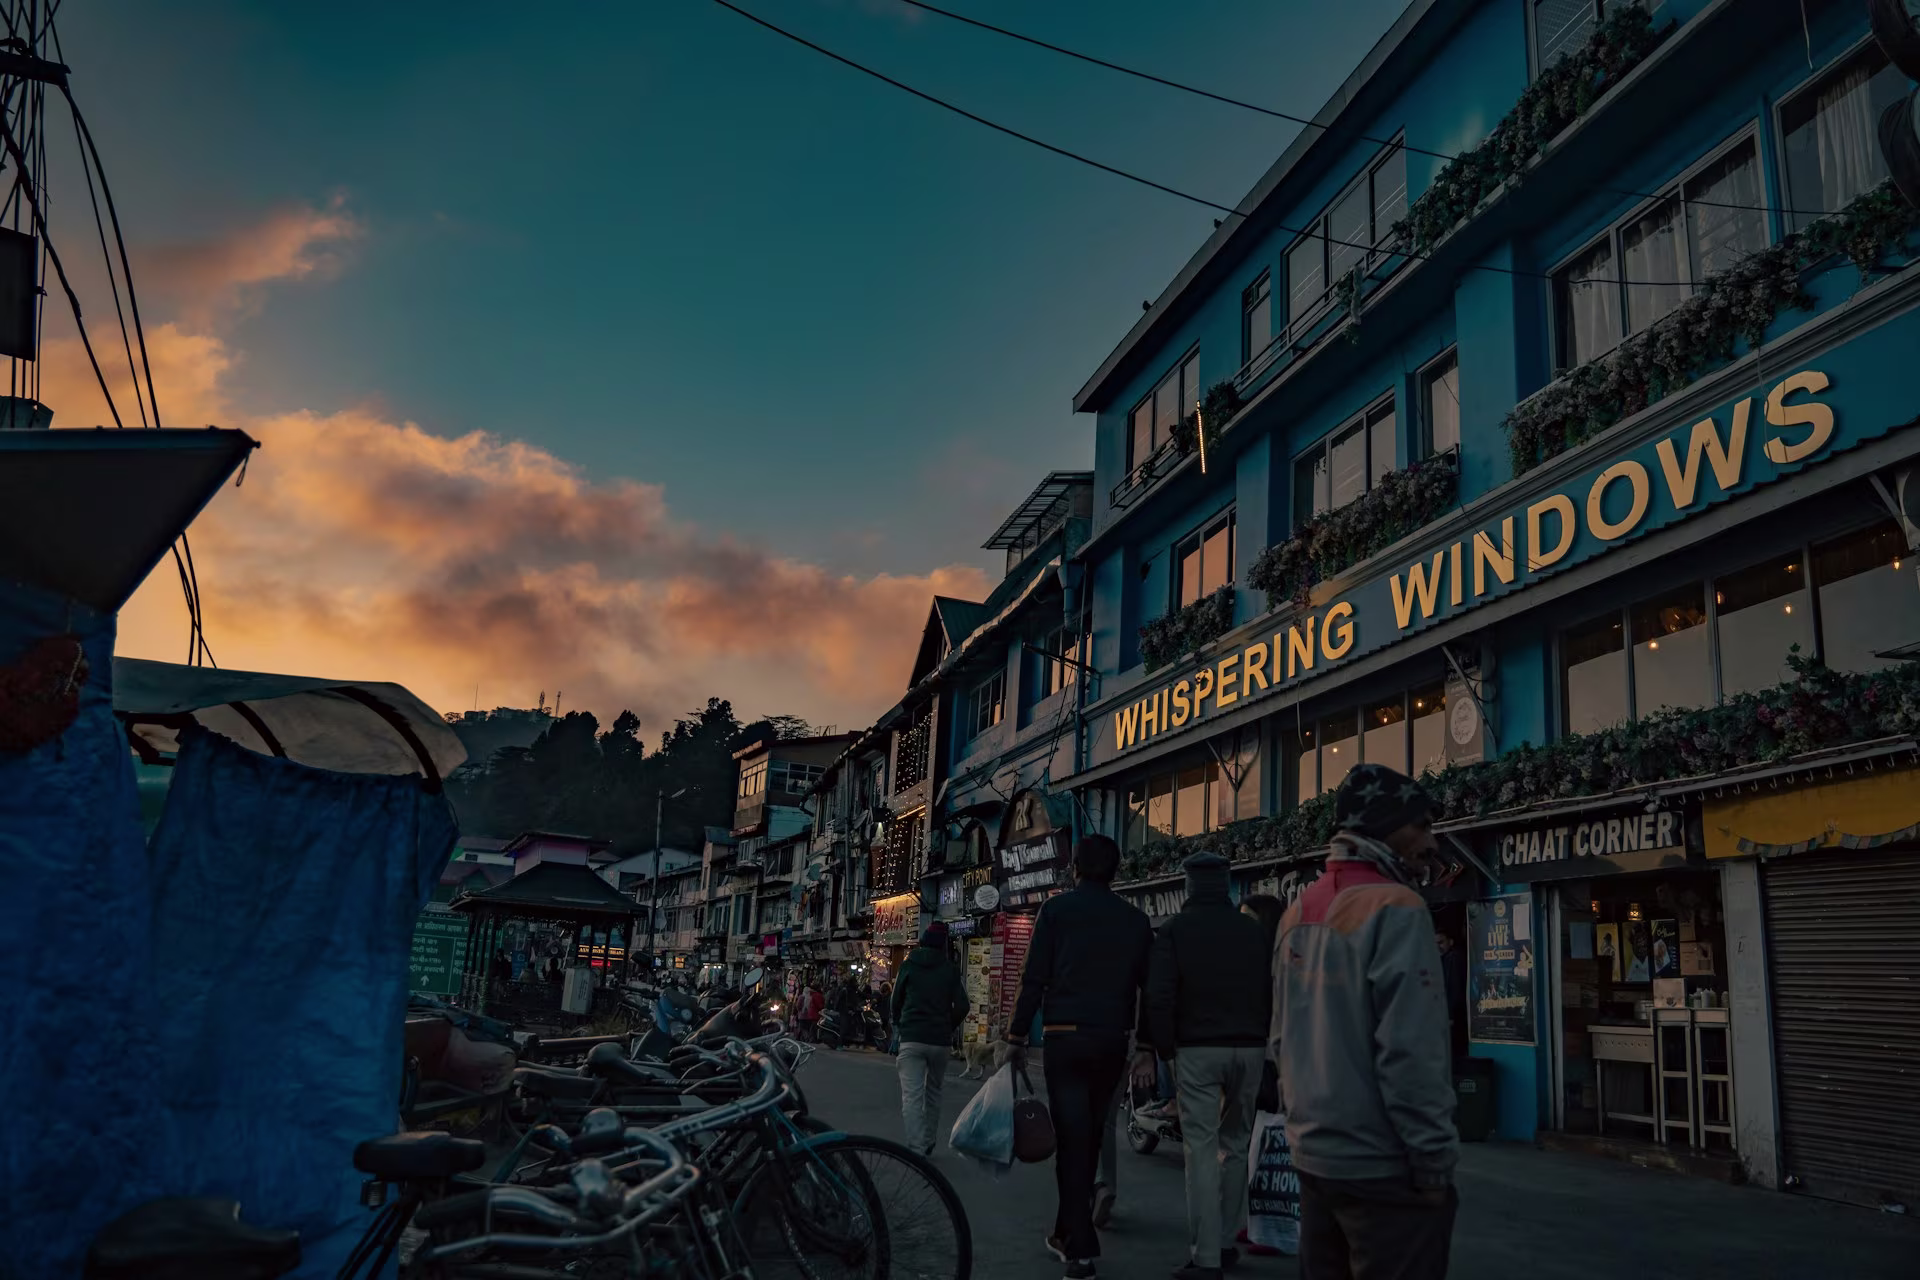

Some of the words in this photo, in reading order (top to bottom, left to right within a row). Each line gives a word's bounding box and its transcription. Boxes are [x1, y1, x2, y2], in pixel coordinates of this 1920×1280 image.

[1113, 599, 1356, 752] WHISPERING
[1389, 369, 1837, 630] WINDOWS
[1502, 827, 1570, 866] CHAAT
[1573, 811, 1674, 856] CORNER
[1487, 931, 1510, 947] LIVE
[1271, 1170, 1300, 1194] HOW
